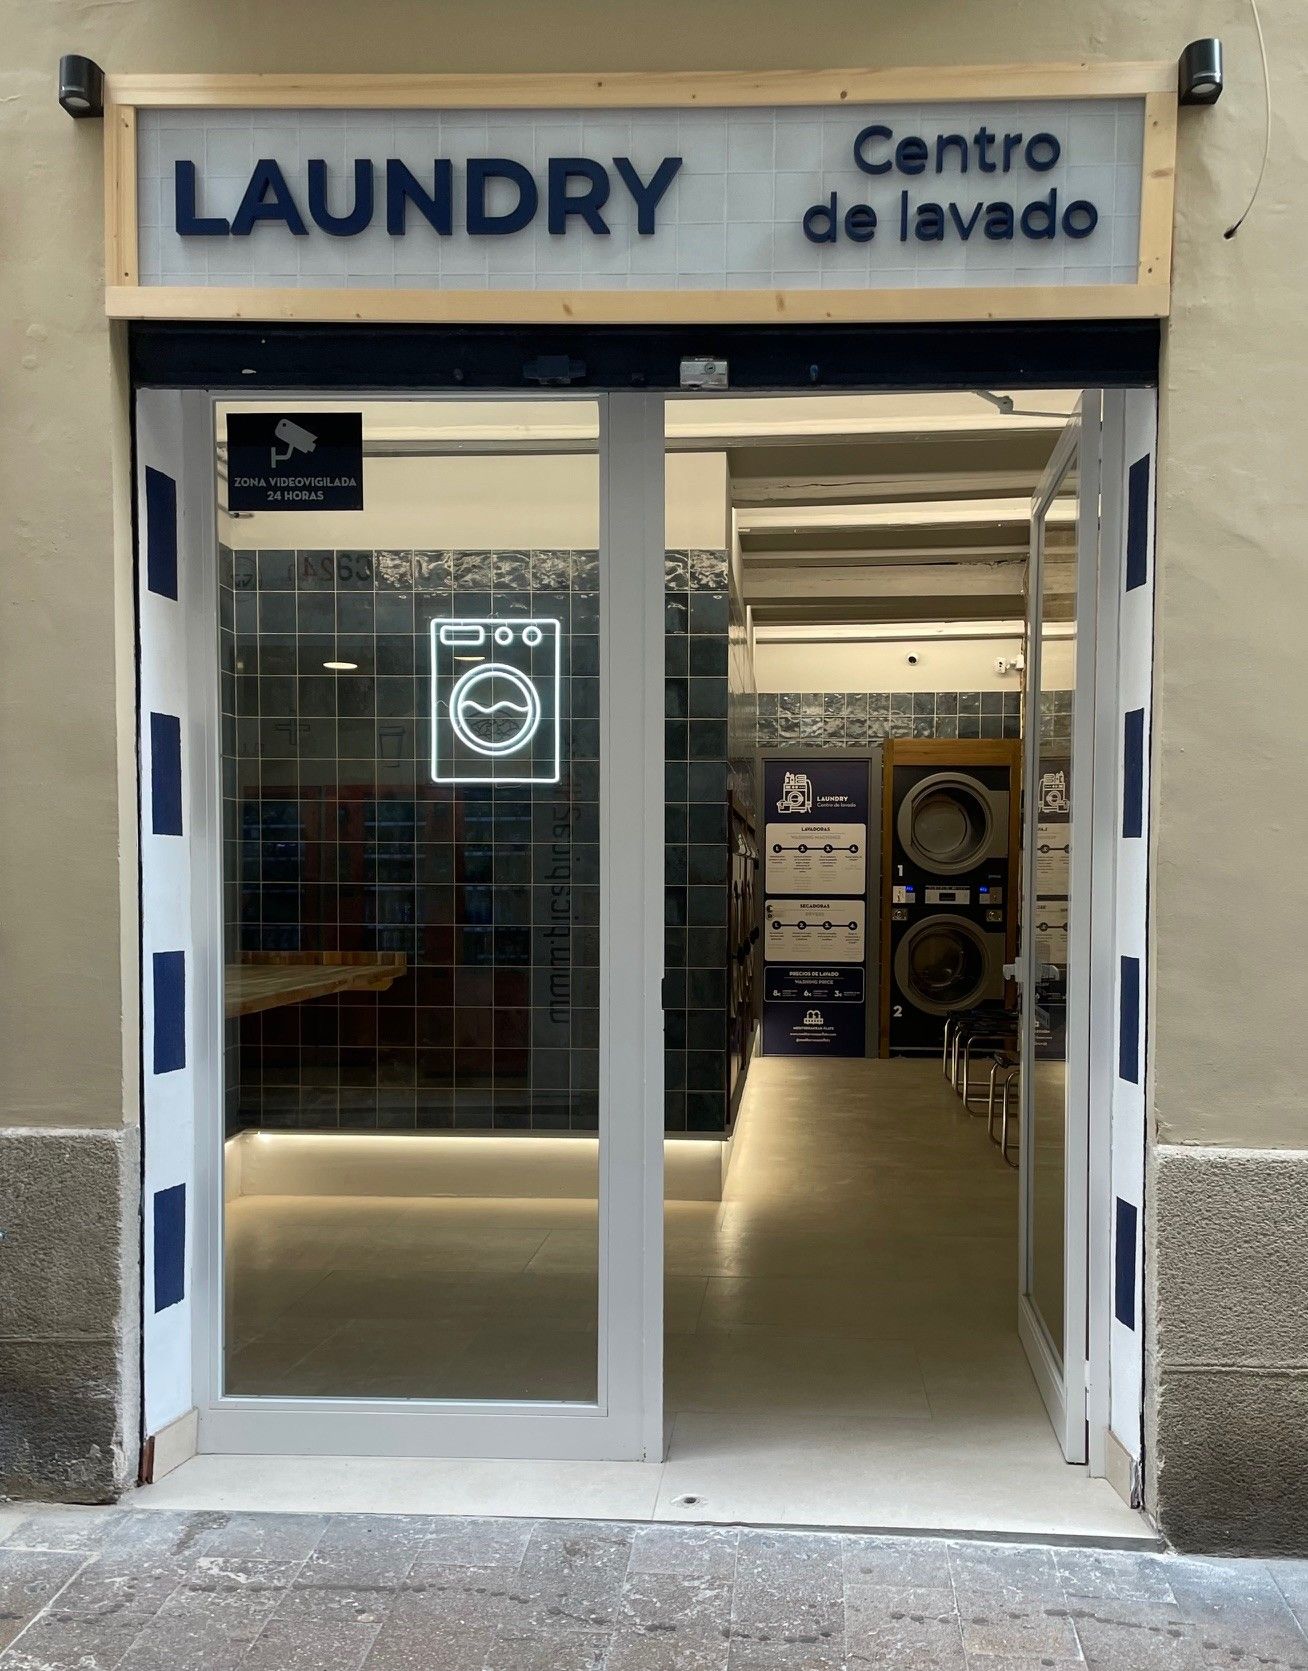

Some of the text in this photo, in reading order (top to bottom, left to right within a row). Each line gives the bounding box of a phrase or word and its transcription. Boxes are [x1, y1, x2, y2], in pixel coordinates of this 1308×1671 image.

[853, 125, 1061, 176] Centro
[175, 157, 682, 237] LAUNDRY
[803, 187, 1099, 244] de lavado
[234, 477, 357, 488] ZONA VIDEOVIGILADA
[266, 490, 324, 501] 24 HORAS
[897, 864, 904, 877] 1
[893, 1005, 903, 1017] 2
